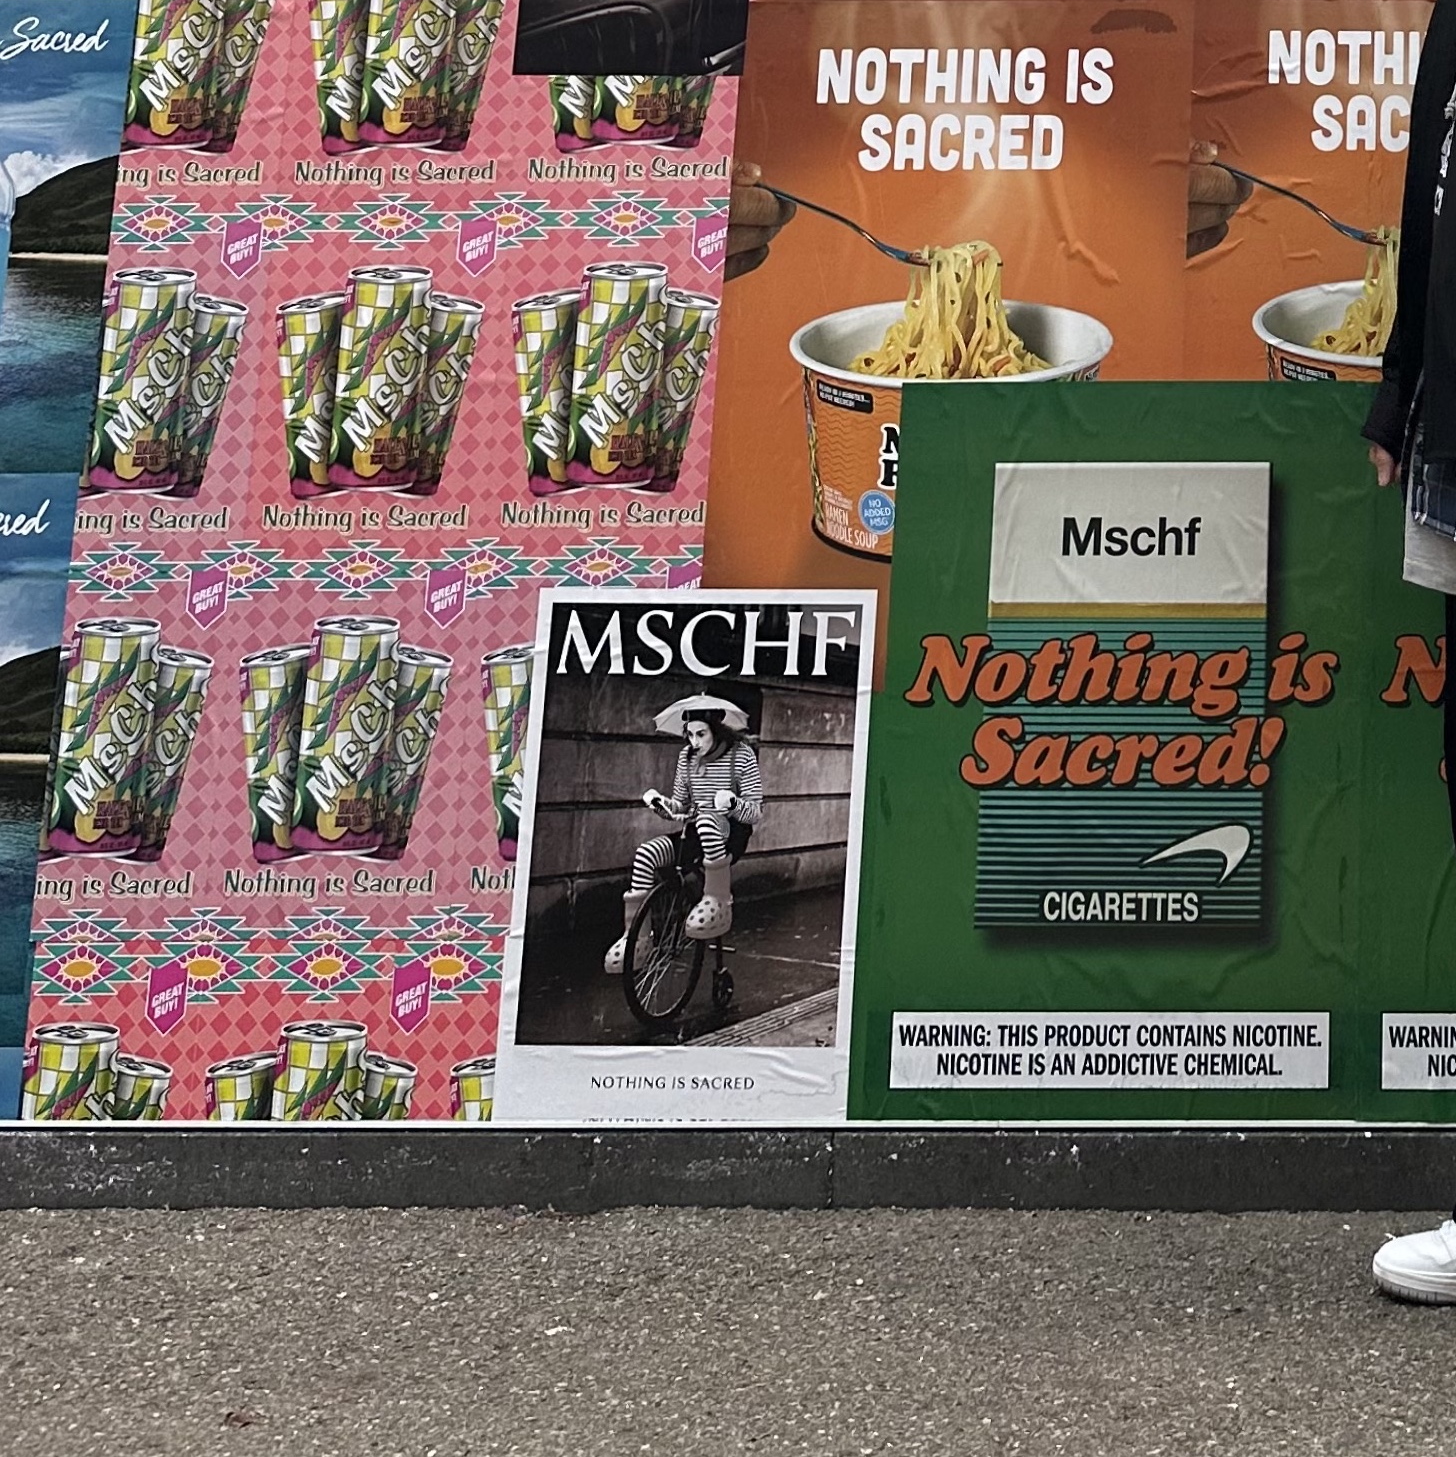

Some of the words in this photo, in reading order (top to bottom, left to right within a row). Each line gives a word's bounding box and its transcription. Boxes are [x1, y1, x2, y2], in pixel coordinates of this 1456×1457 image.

[0, 17, 109, 60] Sacred
[1268, 29, 1421, 84] NOTHI
[817, 48, 1045, 104] NOTHING
[1067, 48, 1113, 104] IS
[1311, 96, 1411, 152] SAC
[859, 113, 1063, 171] SACRED
[296, 161, 382, 186] Nothing
[390, 161, 411, 181] is
[417, 160, 494, 180] Sacred
[529, 158, 615, 182] Nothing
[623, 158, 643, 177] is
[651, 157, 727, 177] Sacred
[864, 507, 891, 517] ADDED
[869, 499, 881, 507] NO
[264, 503, 352, 534] Nothing
[361, 505, 382, 528] is
[387, 505, 466, 526] Sacred
[1062, 517, 1201, 556] Mschf
[193, 581, 224, 604] GREAT
[195, 595, 218, 613] BUY!
[557, 610, 855, 676] MSCHF
[906, 634, 1248, 718] Nothing
[1269, 634, 1337, 702] is
[961, 717, 1284, 786] Sacred!
[225, 869, 316, 898] Nothing
[324, 871, 346, 894] is
[353, 870, 433, 892] Sacred
[1044, 892, 1198, 921] CIGARETTES
[152, 982, 184, 1007] GREAT
[154, 997, 178, 1018] BUY!
[899, 1025, 990, 1046] WARNING:
[998, 1025, 1038, 1046] THIS
[1045, 1025, 1131, 1046] PRODUCT
[1137, 1025, 1226, 1046] CONTAINS
[1233, 1025, 1321, 1047] NICOTINE.
[937, 1053, 1022, 1075] NICOTINE
[1028, 1053, 1044, 1076] IS
[1050, 1053, 1075, 1076] AN
[1082, 1053, 1178, 1075] ADDICTIVE
[1184, 1053, 1282, 1076] CHEMICAL.
[592, 1077, 665, 1089] NOTHING
[672, 1077, 685, 1089] IS
[691, 1077, 754, 1089] SACRED
